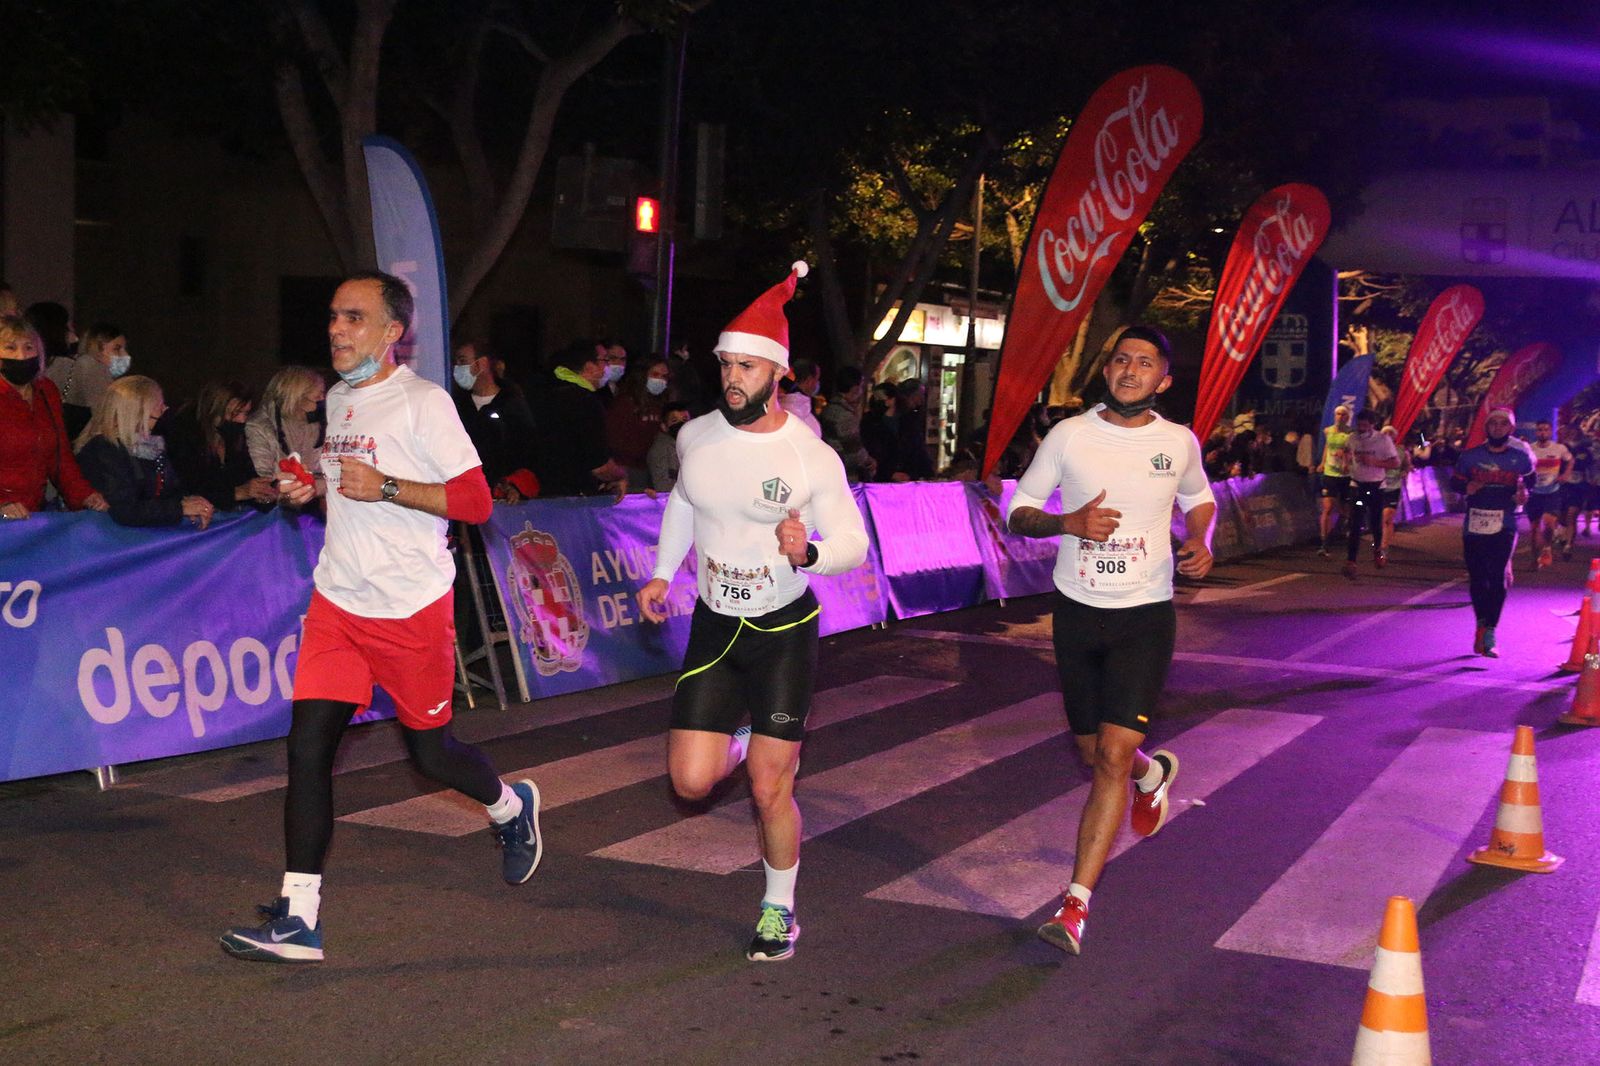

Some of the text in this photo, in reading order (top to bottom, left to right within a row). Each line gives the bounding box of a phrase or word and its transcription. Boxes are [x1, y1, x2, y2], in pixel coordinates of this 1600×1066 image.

[1096, 560, 1126, 574] 908
[720, 584, 751, 601] 756
[598, 592, 633, 629] DE
